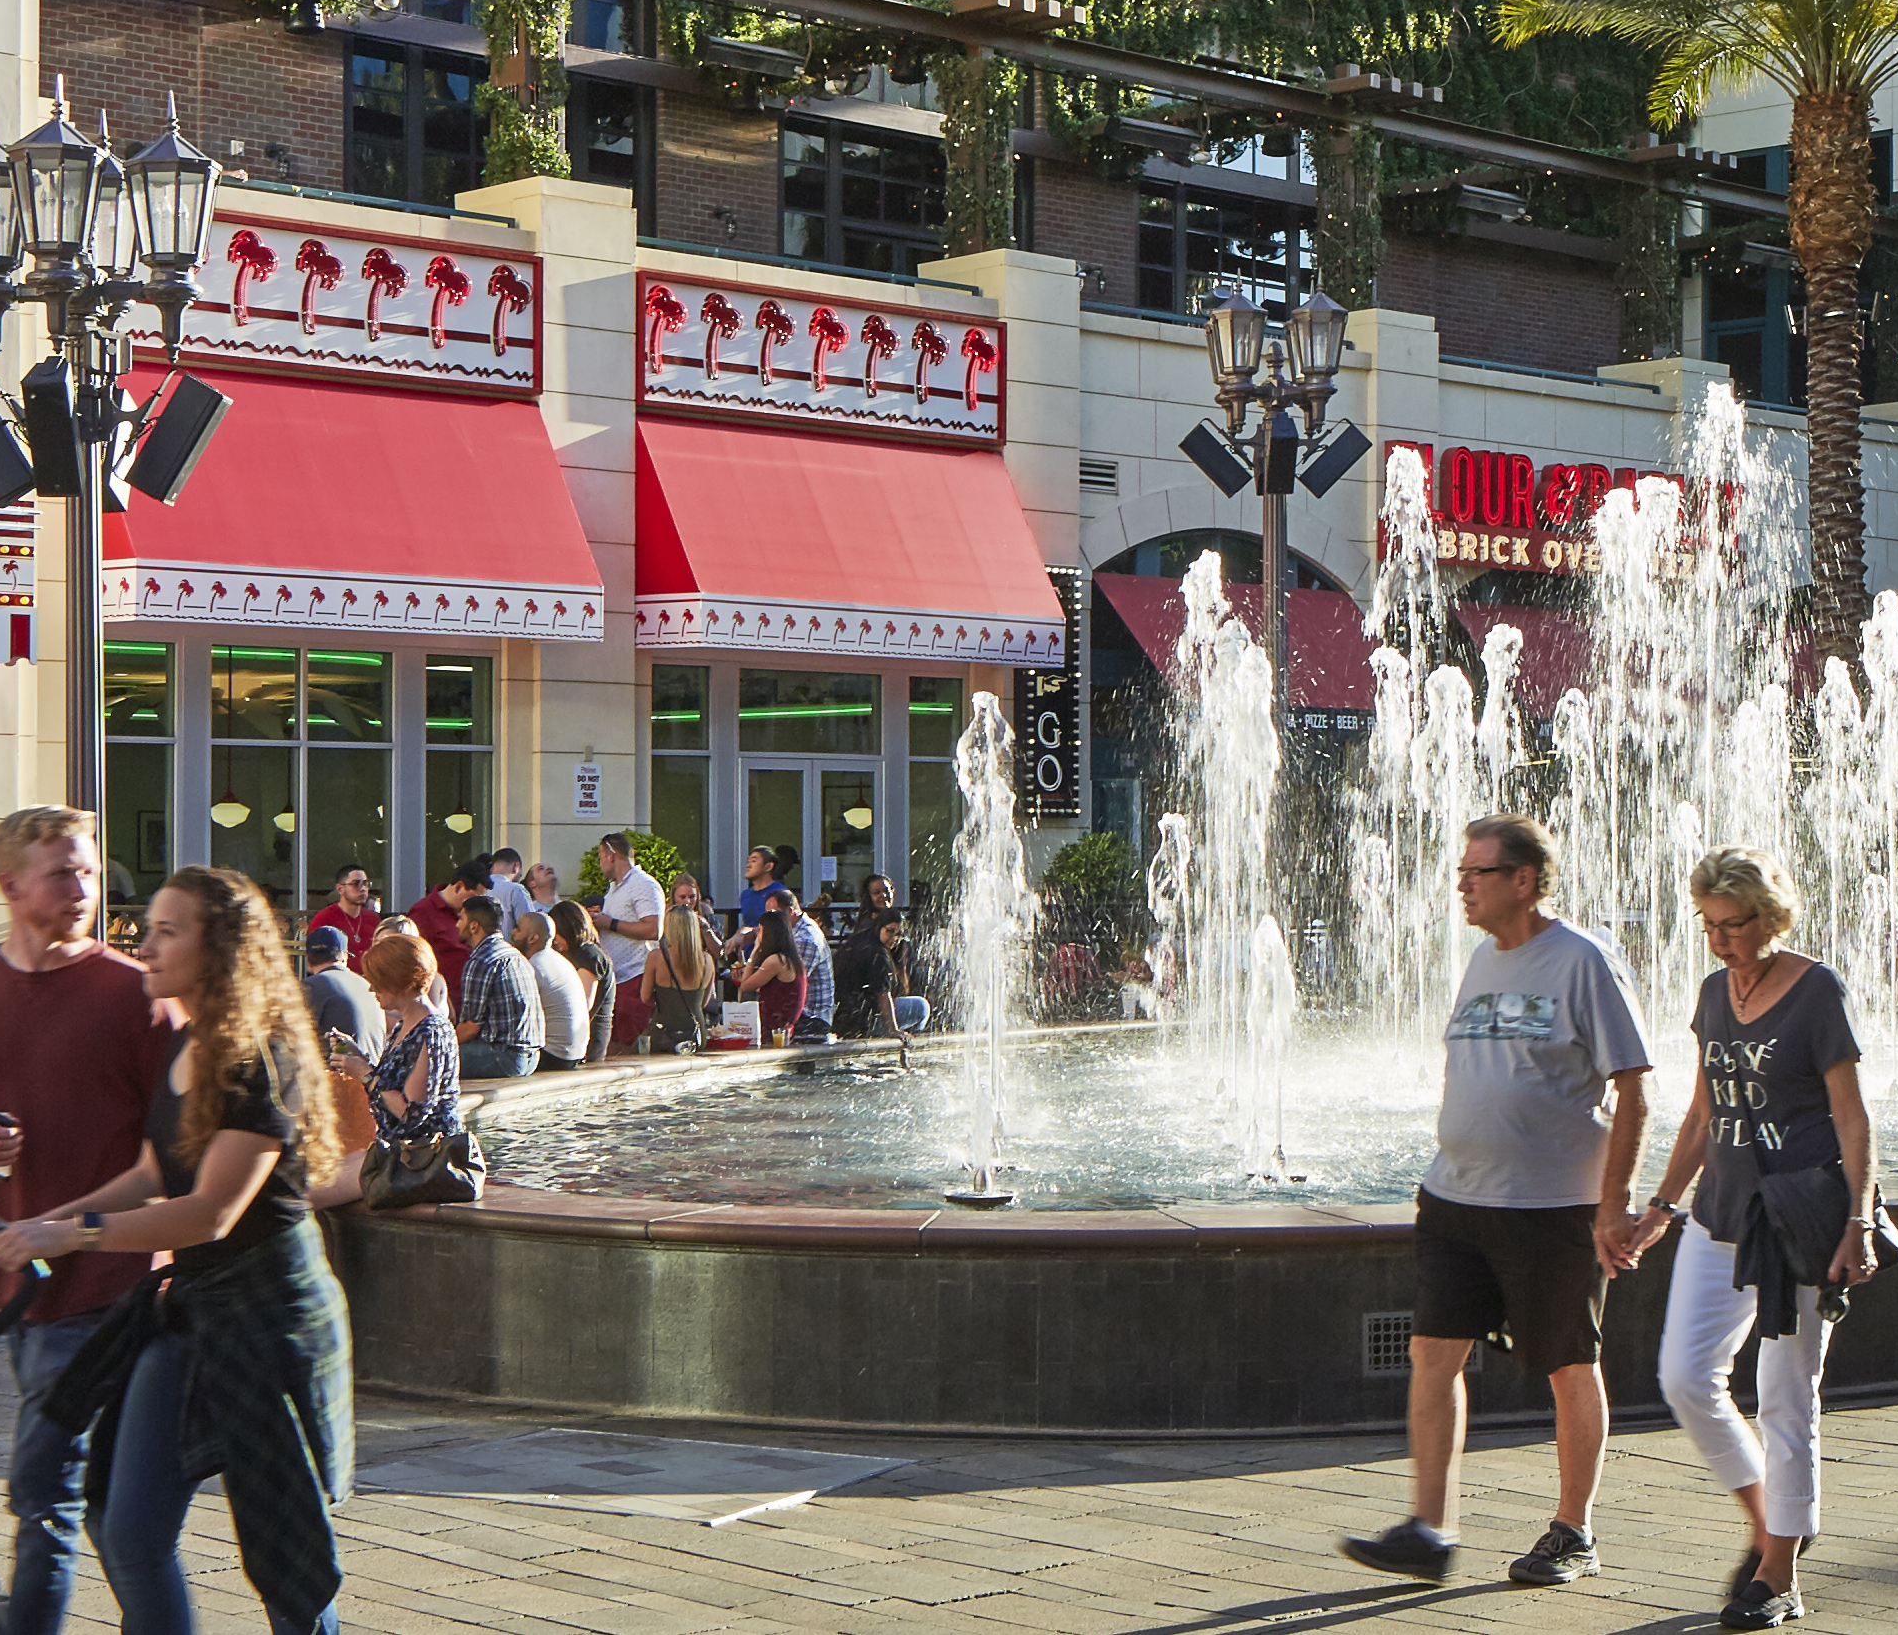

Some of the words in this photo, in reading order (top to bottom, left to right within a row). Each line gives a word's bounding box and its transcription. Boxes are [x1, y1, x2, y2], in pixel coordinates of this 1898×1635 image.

[1384, 440, 1535, 529] LOUR
[1437, 529, 1530, 566] BRICK
[1541, 539, 1602, 573] OVE
[1336, 715, 1359, 730] BEER
[577, 774, 587, 783] DO
[1712, 1078, 1768, 1110] KID
